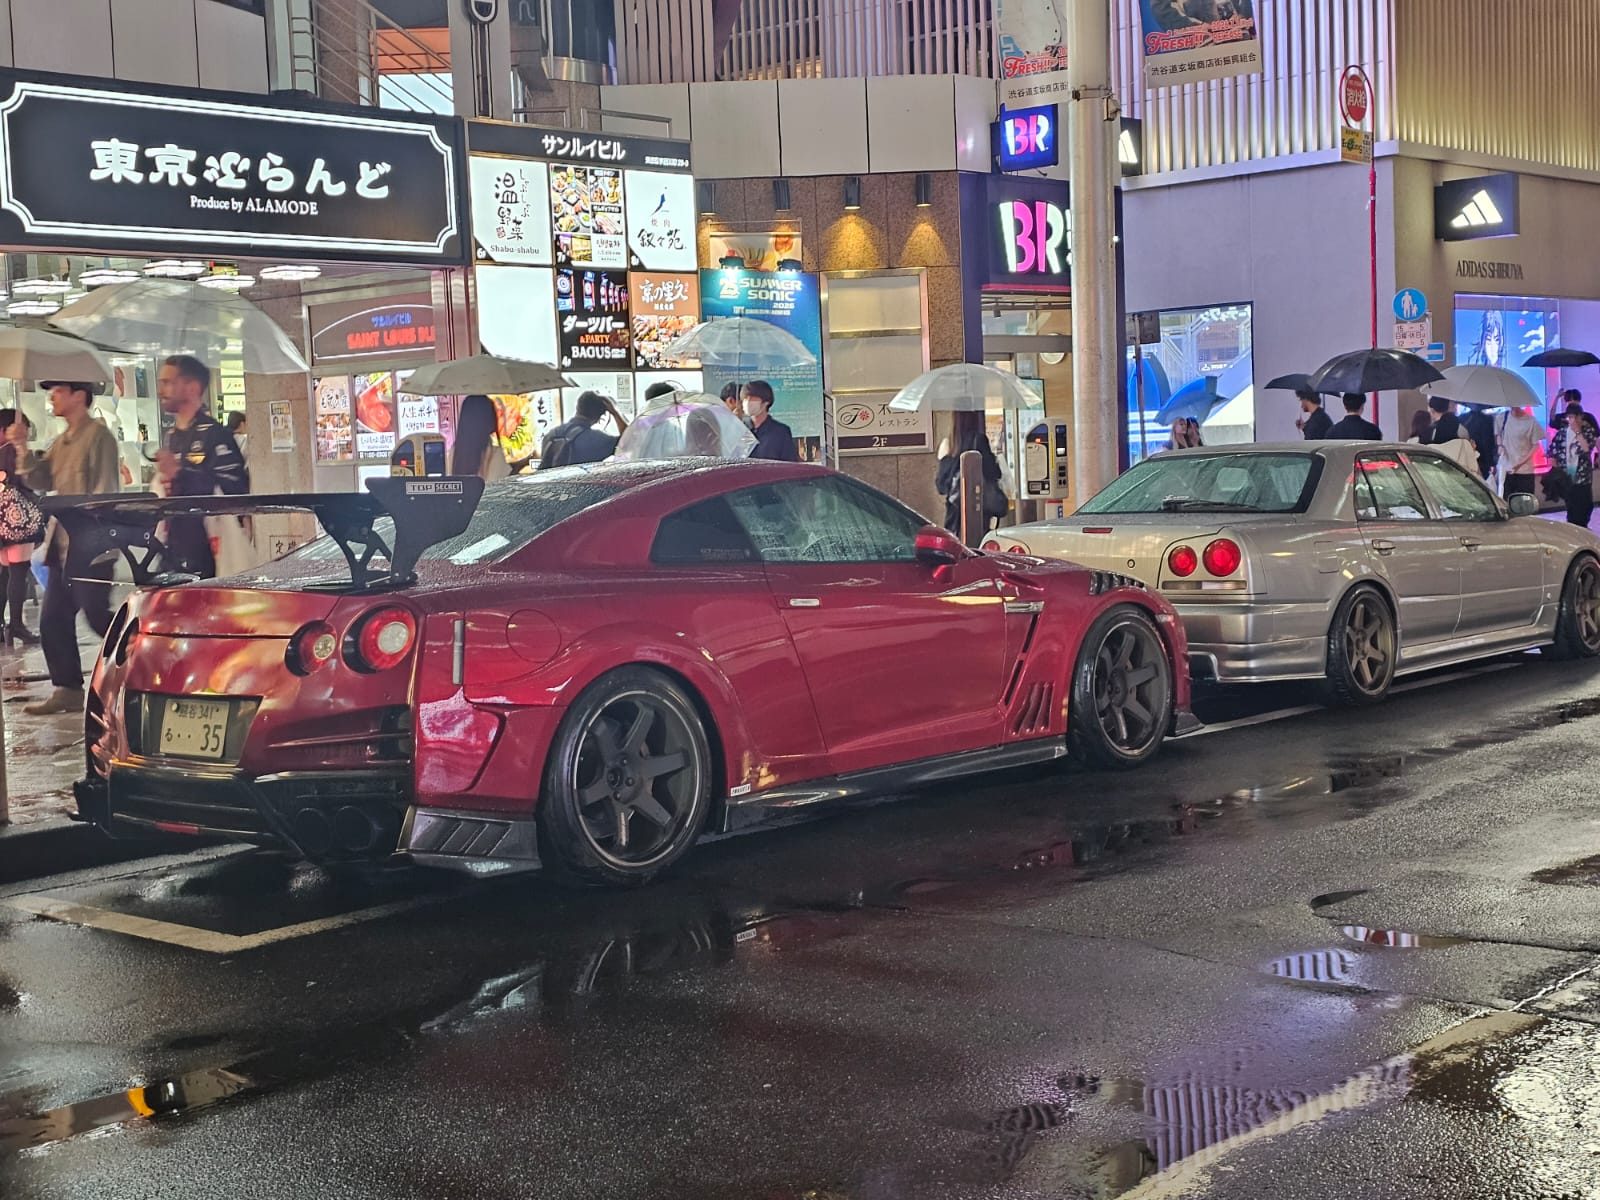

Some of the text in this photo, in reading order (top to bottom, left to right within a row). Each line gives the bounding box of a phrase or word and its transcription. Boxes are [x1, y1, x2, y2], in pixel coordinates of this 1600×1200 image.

[1146, 30, 1204, 54] FRESH!!
[1004, 115, 1050, 156] BR
[541, 134, 627, 161] サンルイビル
[190, 195, 319, 216] Produce by ALAMODE
[1456, 259, 1524, 281] ADIDAS SHIBUYA
[739, 278, 802, 290] SUMMER
[747, 289, 796, 301] SONIC
[562, 314, 626, 333] ダーツバー
[571, 346, 611, 359] BAGUS
[880, 419, 919, 428] レストラン
[872, 436, 888, 447] 2F
[410, 483, 461, 492] TOP SECRET
[200, 724, 223, 752] 35
